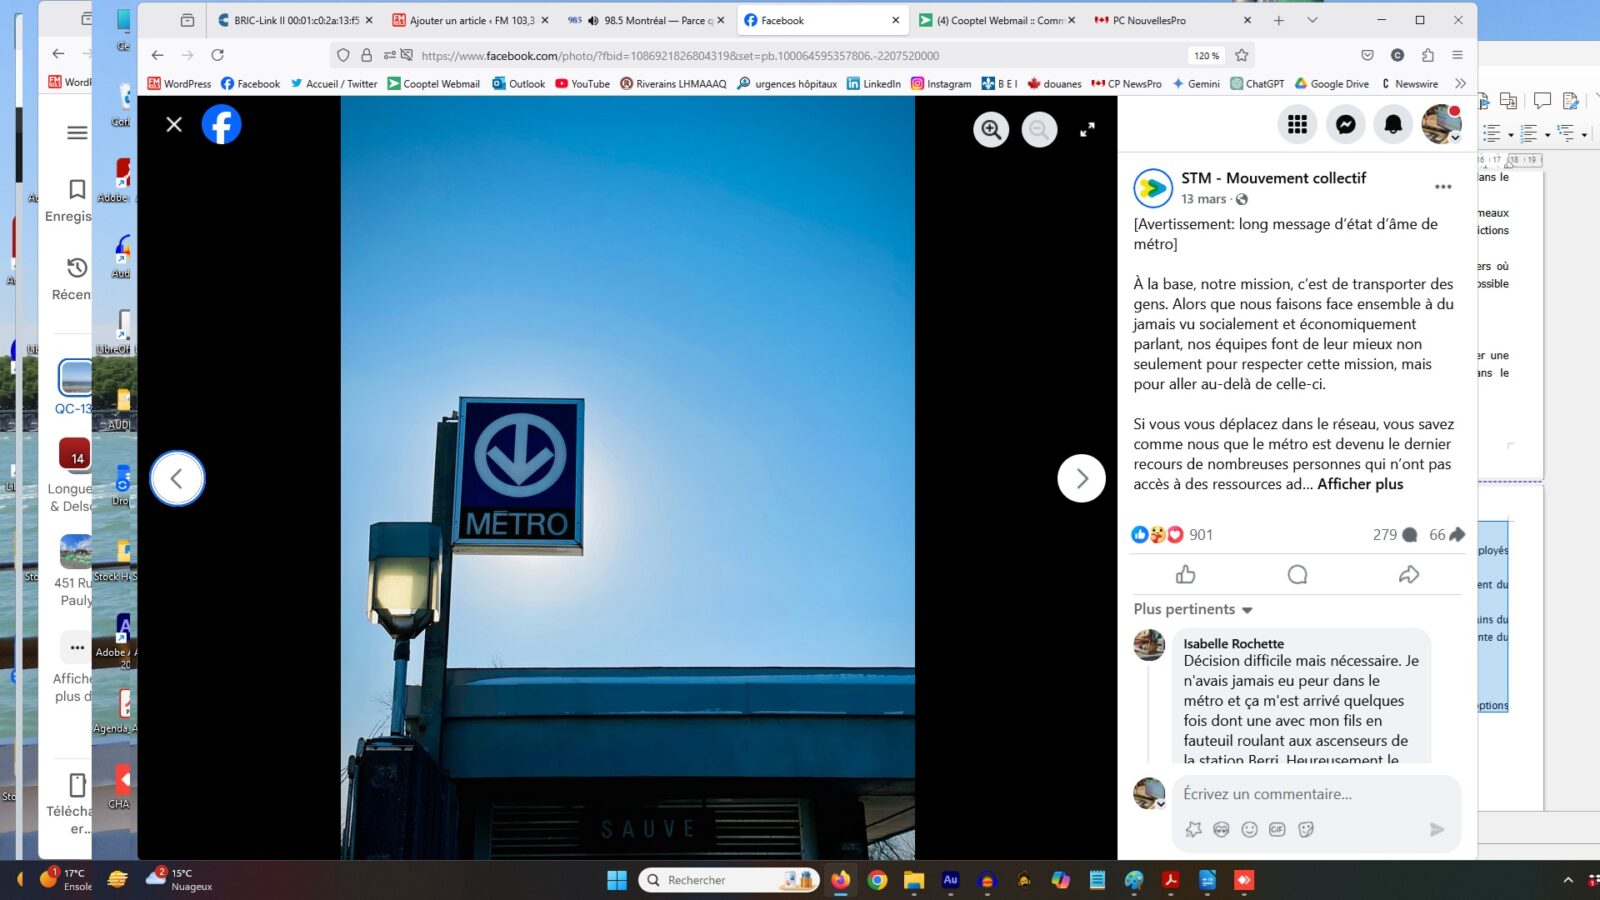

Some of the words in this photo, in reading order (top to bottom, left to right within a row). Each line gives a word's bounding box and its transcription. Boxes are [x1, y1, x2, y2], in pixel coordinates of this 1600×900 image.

[234, 15, 278, 25] BRIC-Link
[409, 16, 444, 28] Ajouter
[459, 16, 487, 25] article
[495, 15, 509, 25] FM
[512, 15, 535, 26] 103,3
[604, 15, 624, 26] 98.5
[625, 15, 667, 26] Montréal
[681, 15, 706, 26] Parce
[761, 15, 805, 25] Facebook
[937, 15, 950, 27] (4)
[950, 15, 987, 28] Cooptel
[988, 15, 1029, 26] Webmail
[1113, 15, 1126, 25] PC
[1127, 15, 1187, 25] NouvellesPro
[1194, 51, 1210, 60] 120
[1211, 51, 1220, 60] %
[163, 79, 212, 89] WordPress
[237, 79, 281, 89] Facebook
[306, 79, 339, 89] Accueil
[346, 79, 378, 89] Twitter
[403, 79, 439, 91] Cooptel
[441, 79, 481, 89] Webmail
[509, 79, 546, 89] Outlook
[571, 79, 611, 89] YouTube
[636, 79, 677, 89] Riverains
[678, 79, 727, 90] LHMAAAQ
[755, 81, 797, 91] urgences
[798, 79, 838, 91] hôpitaux
[863, 79, 902, 89] LinkedIn
[927, 79, 972, 91] Instagram
[998, 79, 1005, 89] B
[1006, 79, 1013, 89] E
[1043, 79, 1082, 89] douanes
[1107, 79, 1121, 89] CP
[1122, 79, 1163, 89] NewsPro
[1188, 79, 1221, 89] Gemini
[1245, 79, 1285, 89] ChatGPT
[1310, 79, 1344, 91] Google
[1345, 79, 1370, 89] Drive
[1395, 79, 1439, 89] Newswire
[1181, 171, 1212, 185] STM
[1226, 171, 1310, 185] Mouvement
[1312, 170, 1368, 185] collectif
[1499, 171, 1510, 182] le
[97, 193, 127, 202] Adobe
[1181, 193, 1194, 205] 13
[1197, 195, 1227, 205] mars
[45, 210, 92, 225] Enregis
[1134, 217, 1235, 233] [Avertissement:
[1239, 216, 1269, 234] long
[1272, 220, 1331, 234] message
[1421, 216, 1439, 230] de
[1134, 237, 1178, 253] métro]
[1496, 260, 1509, 271] où
[1133, 274, 1144, 290] À
[1147, 276, 1159, 290] la
[1163, 276, 1197, 292] base,
[1200, 278, 1237, 290] notre
[1240, 277, 1294, 292] mission,
[1331, 276, 1349, 290] de
[1352, 278, 1427, 294] transporter
[1430, 276, 1454, 290] des
[1490, 352, 1510, 361] une
[1500, 367, 1510, 378] le
[1134, 380, 1166, 394] pour
[1168, 376, 1198, 390] aller
[1200, 376, 1251, 390] au-delà
[1255, 376, 1273, 390] de
[1275, 376, 1326, 390] celle-ci.
[1133, 417, 1145, 430] Si
[1148, 420, 1181, 430] vous
[1183, 420, 1216, 430] vous
[1219, 416, 1278, 433] déplacez
[1281, 416, 1314, 430] dans
[1317, 416, 1329, 430] le
[1332, 417, 1380, 432] réseau,
[1383, 420, 1415, 430] vous
[1418, 420, 1455, 430] savez
[71, 453, 85, 464] 14
[47, 483, 92, 498] Longue
[1133, 477, 1170, 490] accès
[1173, 477, 1181, 490] à
[1184, 477, 1209, 490] des
[1212, 480, 1282, 490] ressources
[1285, 476, 1314, 490] ad...
[1316, 476, 1372, 490] Afficher
[1375, 476, 1404, 494] plus
[466, 511, 569, 537] MÉTRO
[1189, 528, 1212, 541] 901
[1373, 528, 1398, 541] 279
[1429, 528, 1446, 541] 66
[54, 577, 74, 589] 451
[1496, 579, 1508, 590] du
[1134, 601, 1162, 615] Plus
[1165, 602, 1236, 619] pertinents
[1496, 614, 1508, 625] du
[1496, 631, 1508, 642] du
[1183, 637, 1229, 650] Isabelle
[1231, 637, 1285, 650] Rochette
[1184, 654, 1240, 667] Décision
[1243, 653, 1292, 667] difficile
[1295, 654, 1327, 667] mais
[1330, 654, 1402, 667] nécessaire.
[1405, 654, 1420, 667] Je
[1230, 674, 1275, 690] jamais
[1277, 677, 1295, 687] eu
[1298, 677, 1330, 690] peur
[1332, 673, 1365, 687] dans
[1368, 673, 1380, 687] le
[55, 690, 81, 705] plus
[1183, 784, 1229, 800] Écrivez
[1232, 790, 1250, 800] un
[1253, 787, 1352, 800] commentaire...
[601, 819, 693, 839] SAUVE
[64, 869, 85, 878] 17°C
[171, 869, 193, 878] 15°C
[668, 875, 726, 885] Rechercher
[943, 875, 957, 884] Au
[171, 882, 213, 894] Nuageux
